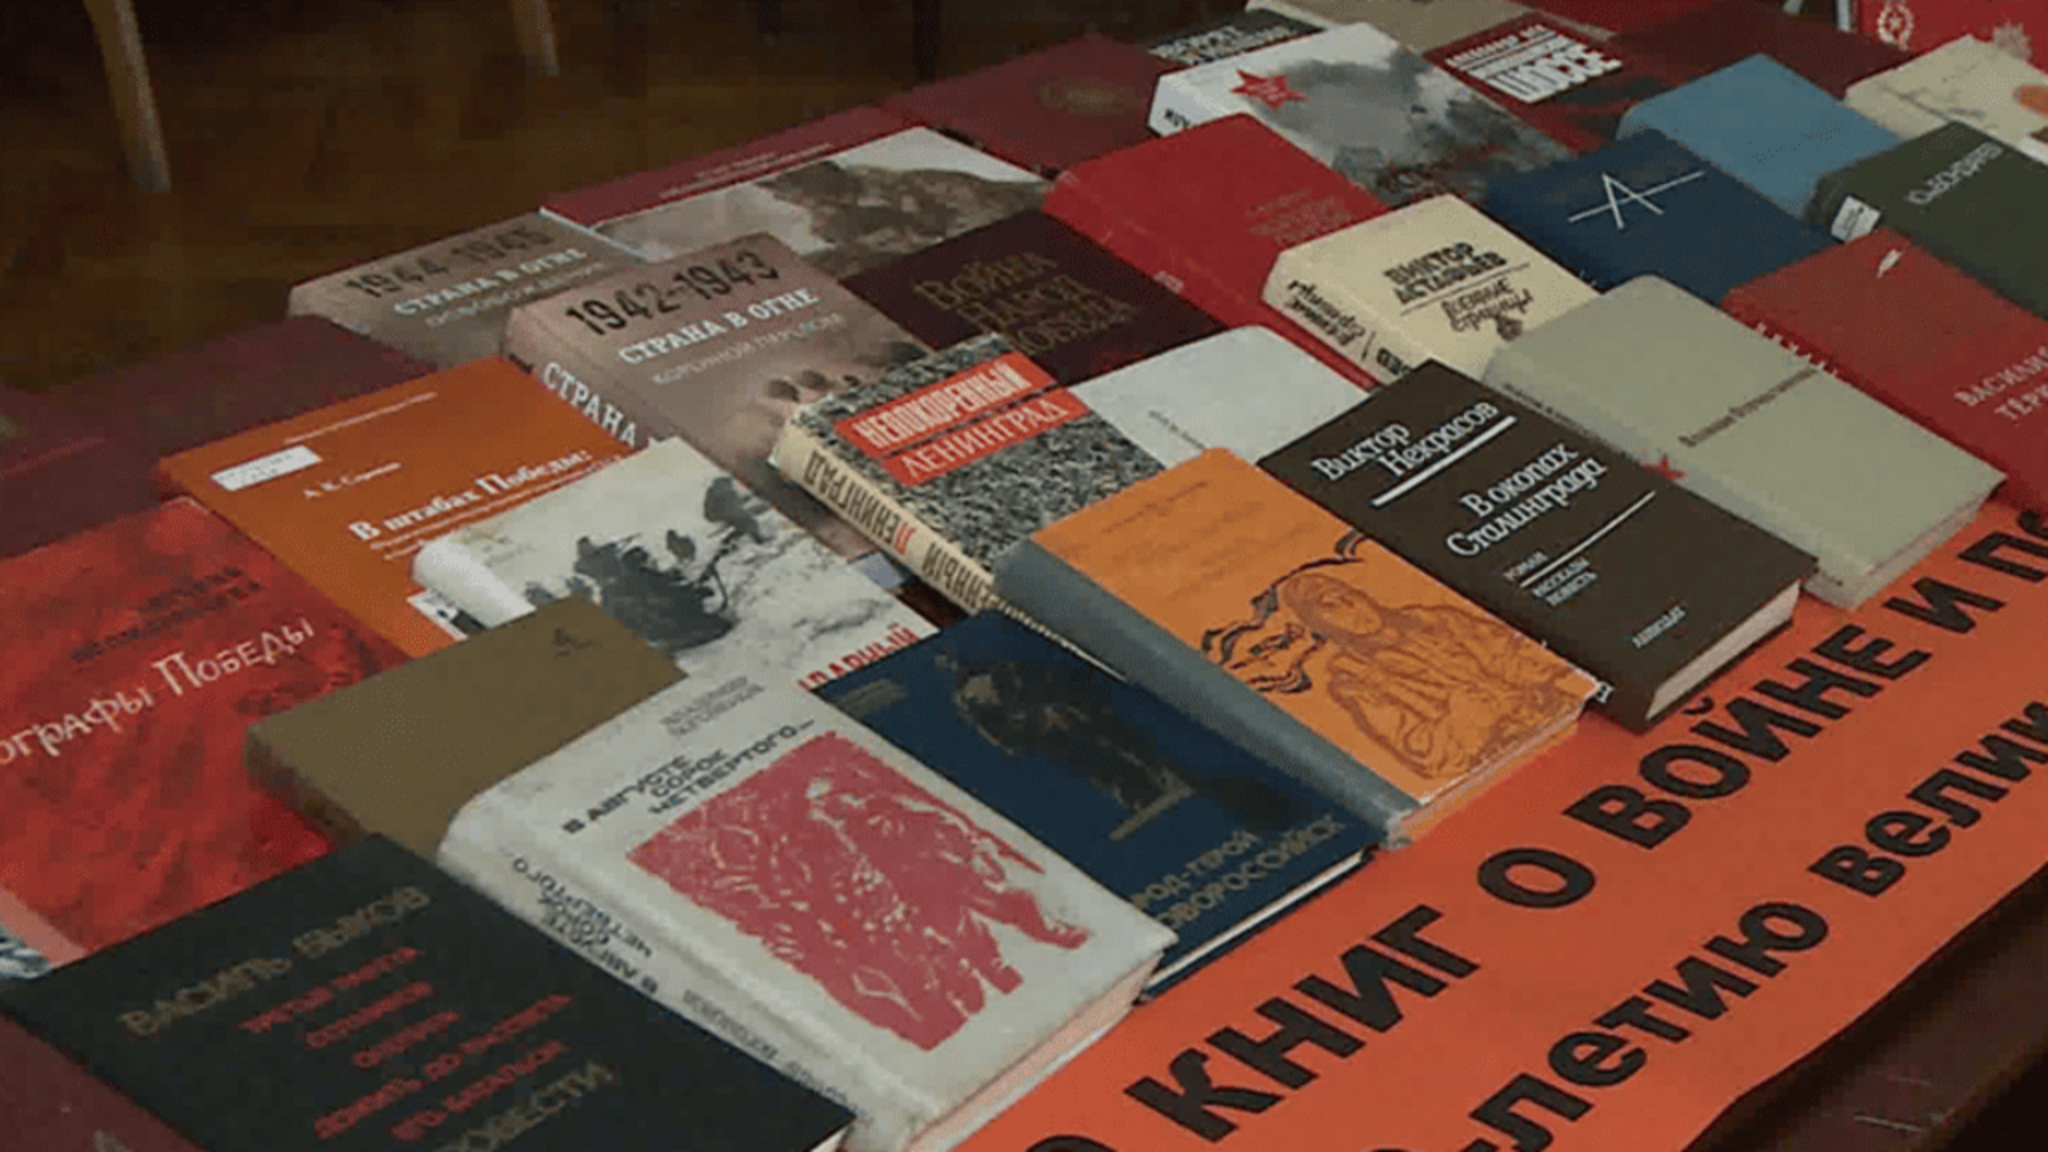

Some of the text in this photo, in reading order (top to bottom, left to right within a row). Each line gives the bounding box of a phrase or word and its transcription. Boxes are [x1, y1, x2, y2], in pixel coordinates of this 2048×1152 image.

[565, 249, 781, 337] 1942-1943
[1383, 241, 1475, 285] ВИКТОР
[617, 288, 821, 366] СТРАНА В ОГНЕ
[542, 361, 637, 448] СТРАНА
[851, 359, 1033, 450] НЕПОКОРЕННЫЙ
[900, 397, 1069, 479] ЛЕНИНГРАД
[1377, 401, 1499, 478] Некрасов
[1310, 421, 1412, 482] Виктор
[1459, 442, 1579, 519] В окопах
[348, 521, 380, 541] В
[383, 488, 481, 532] штабах
[803, 449, 917, 556] ЛЕНИНГРАД
[1445, 456, 1608, 557] Сталинграда
[1122, 904, 1481, 1143] КНИГ
[1476, 847, 1597, 909] О
[1561, 624, 1934, 851] ВОЙНЕ
[1881, 576, 2007, 635] И
[117, 957, 294, 1037] ВАСИЛЬ
[1370, 902, 1829, 1152] -летию
